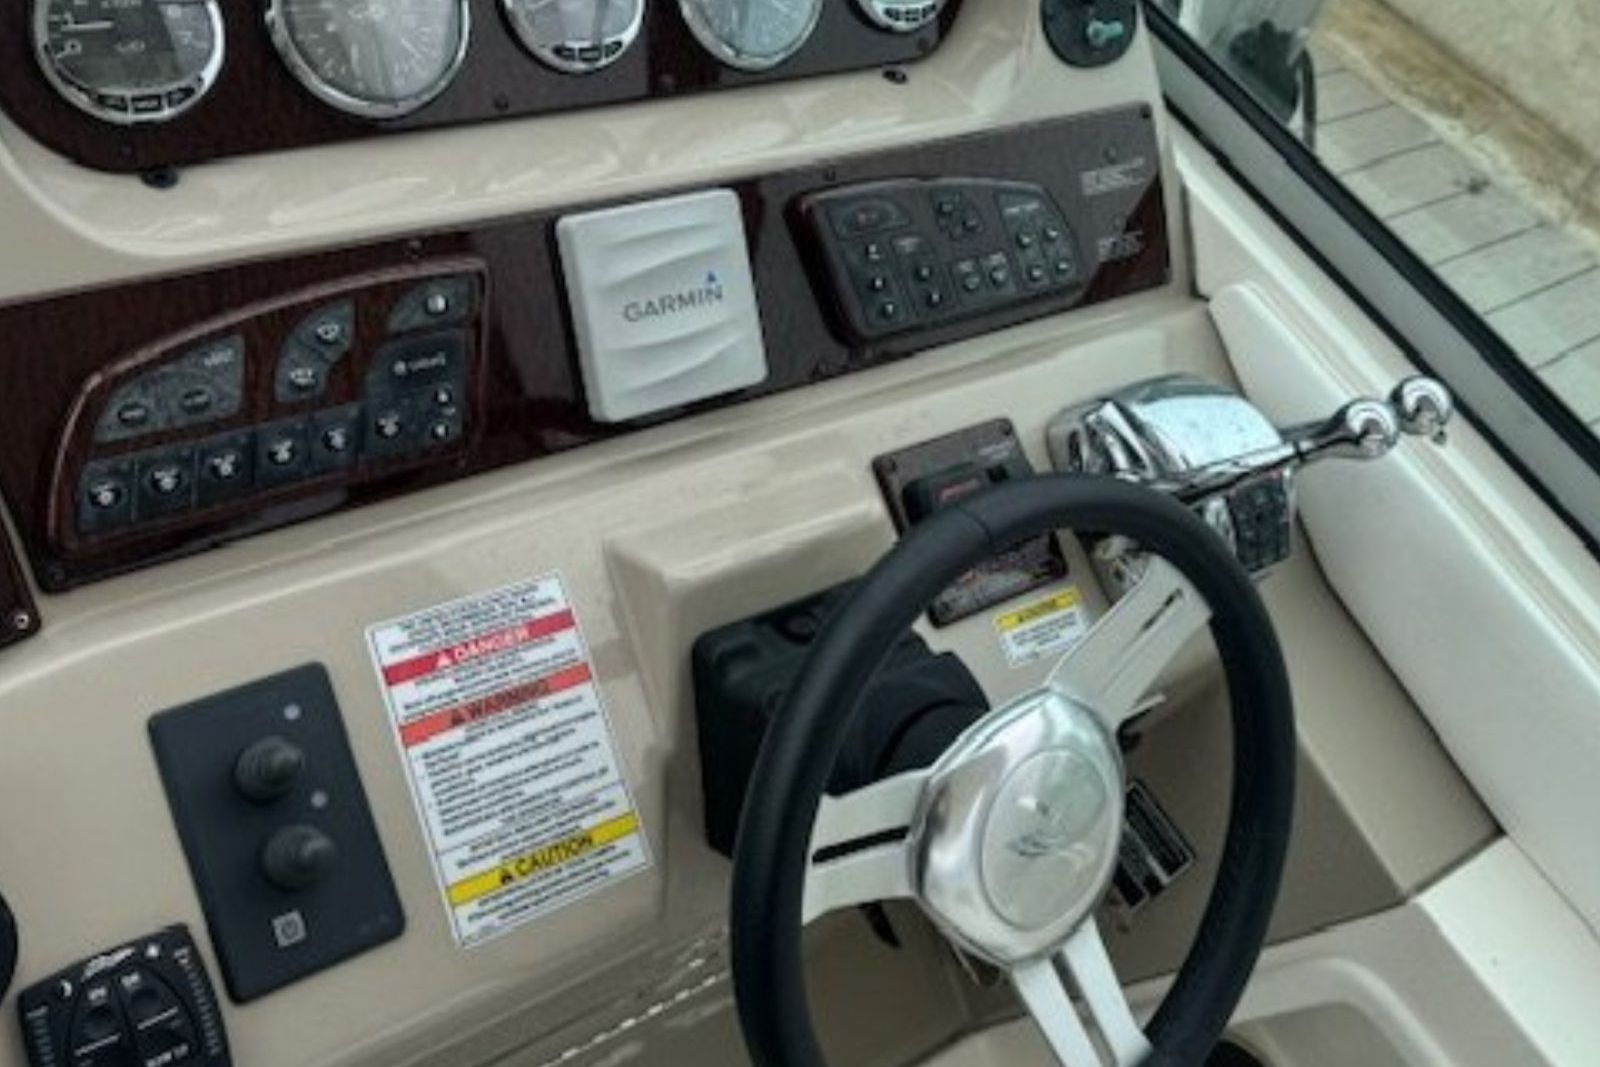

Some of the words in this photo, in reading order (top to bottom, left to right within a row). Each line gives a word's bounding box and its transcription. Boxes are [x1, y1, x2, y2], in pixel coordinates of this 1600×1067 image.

[623, 284, 723, 322] GARMIN
[454, 627, 530, 660] DANGER
[468, 679, 550, 719] WARNING
[514, 834, 593, 876] CAUTION
